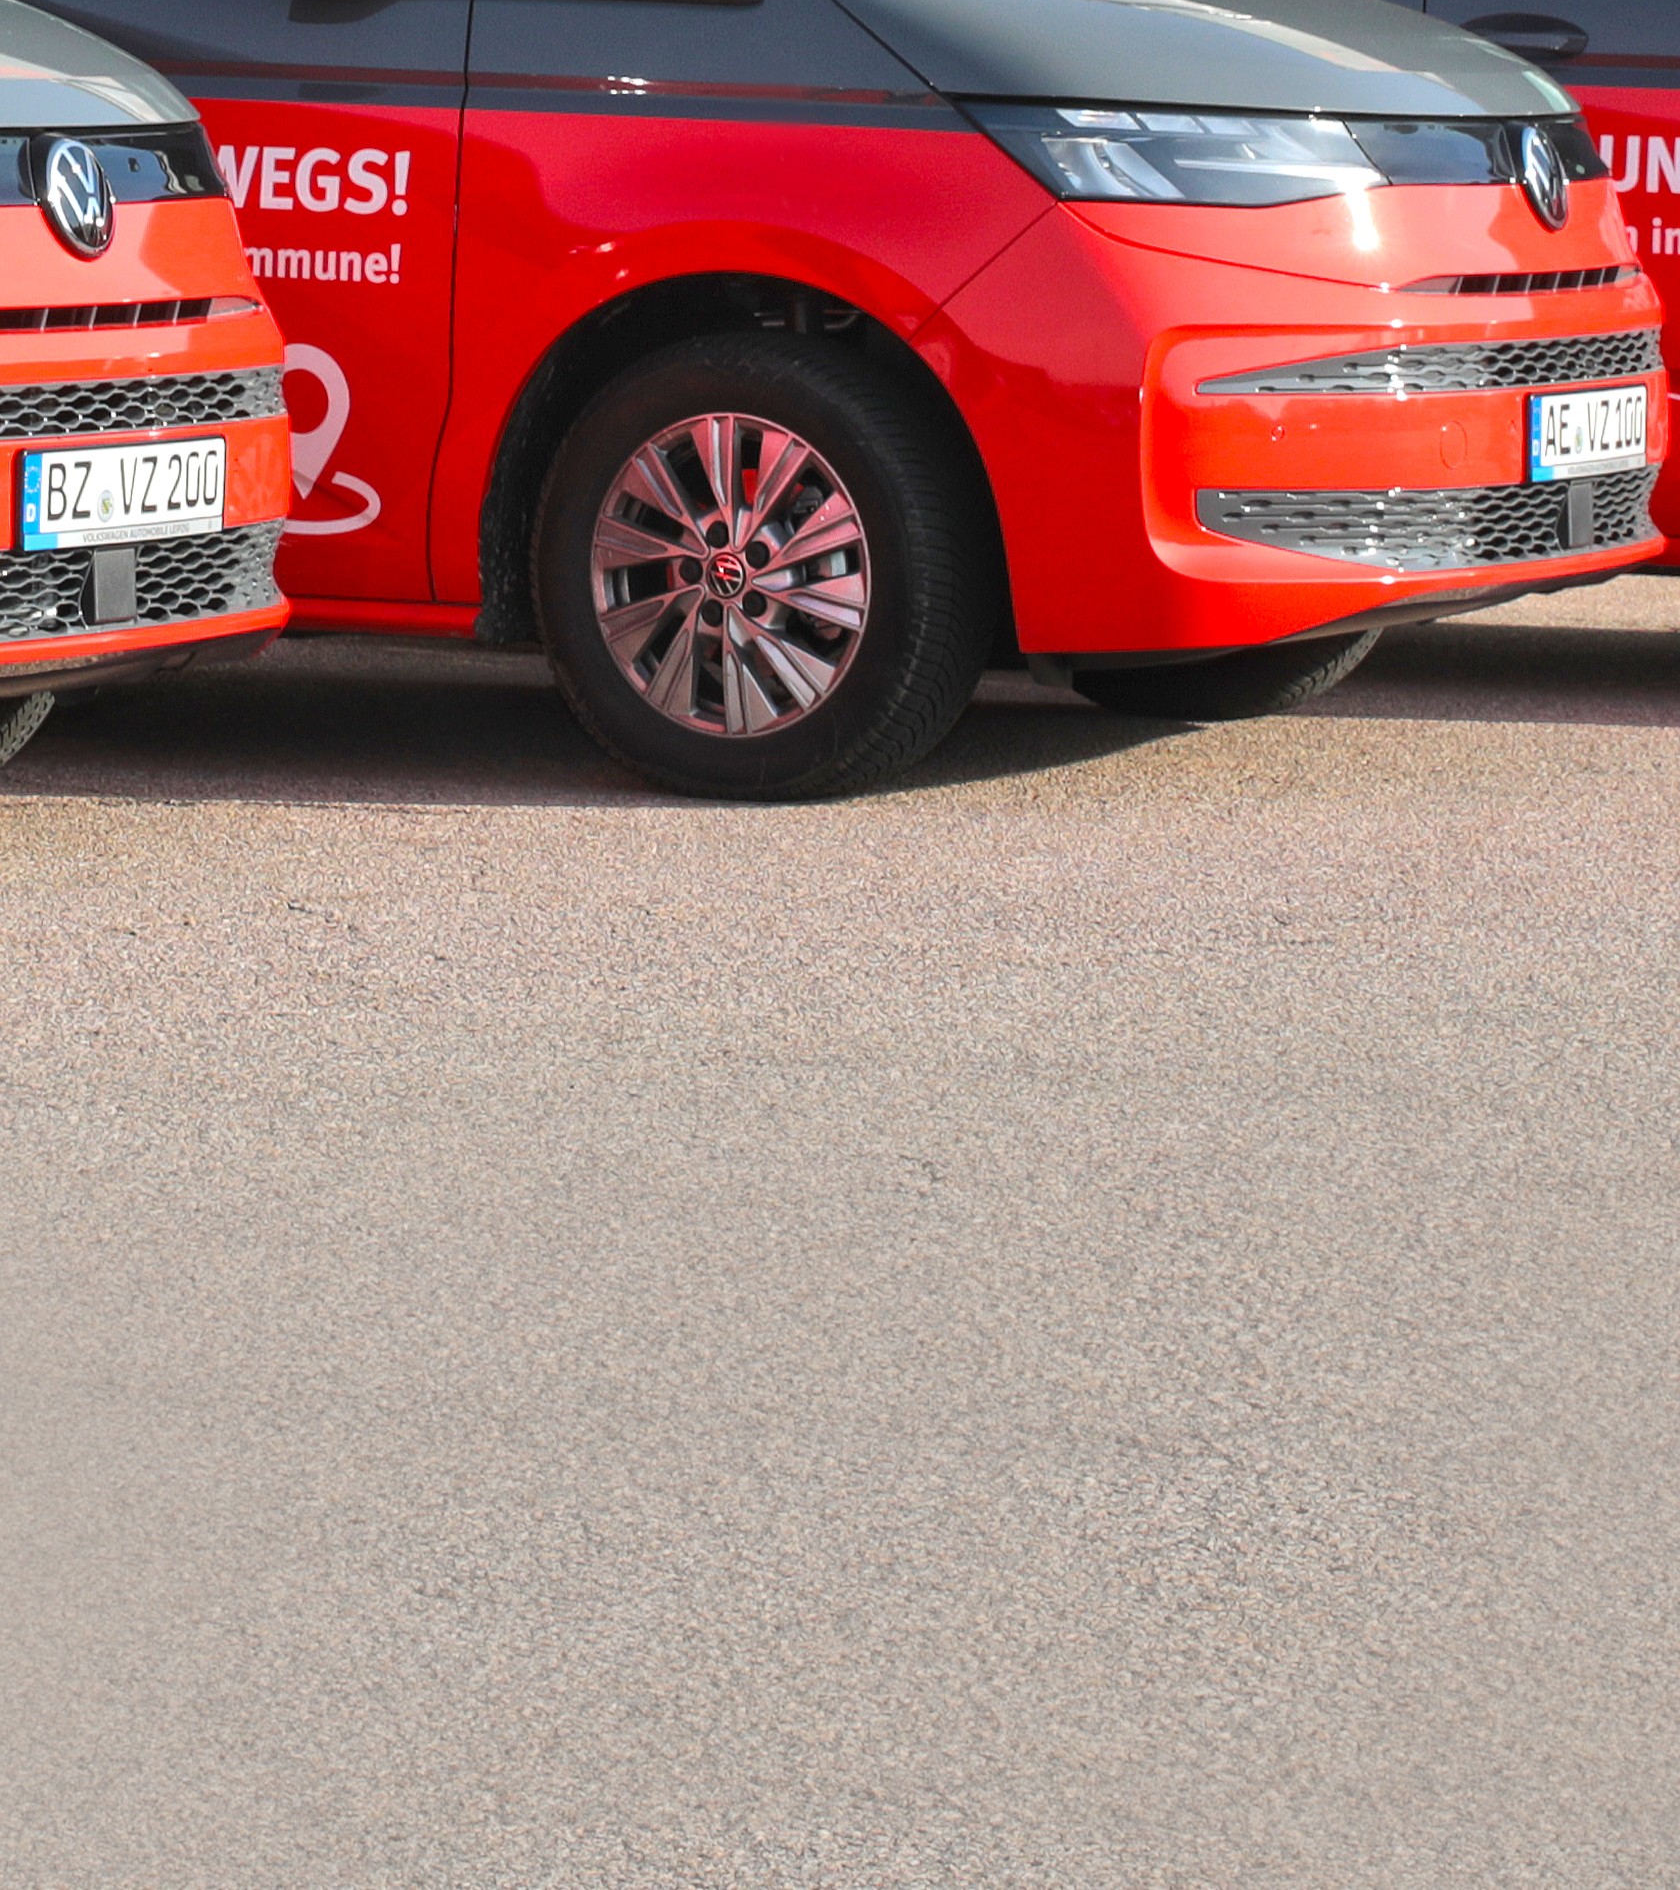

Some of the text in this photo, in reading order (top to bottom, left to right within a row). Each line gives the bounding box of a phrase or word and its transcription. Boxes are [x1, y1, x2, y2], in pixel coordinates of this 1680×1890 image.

[1544, 403, 1571, 457] AE
[1587, 399, 1610, 453] VZ
[46, 460, 92, 521] BZ
[119, 455, 158, 515] VZ
